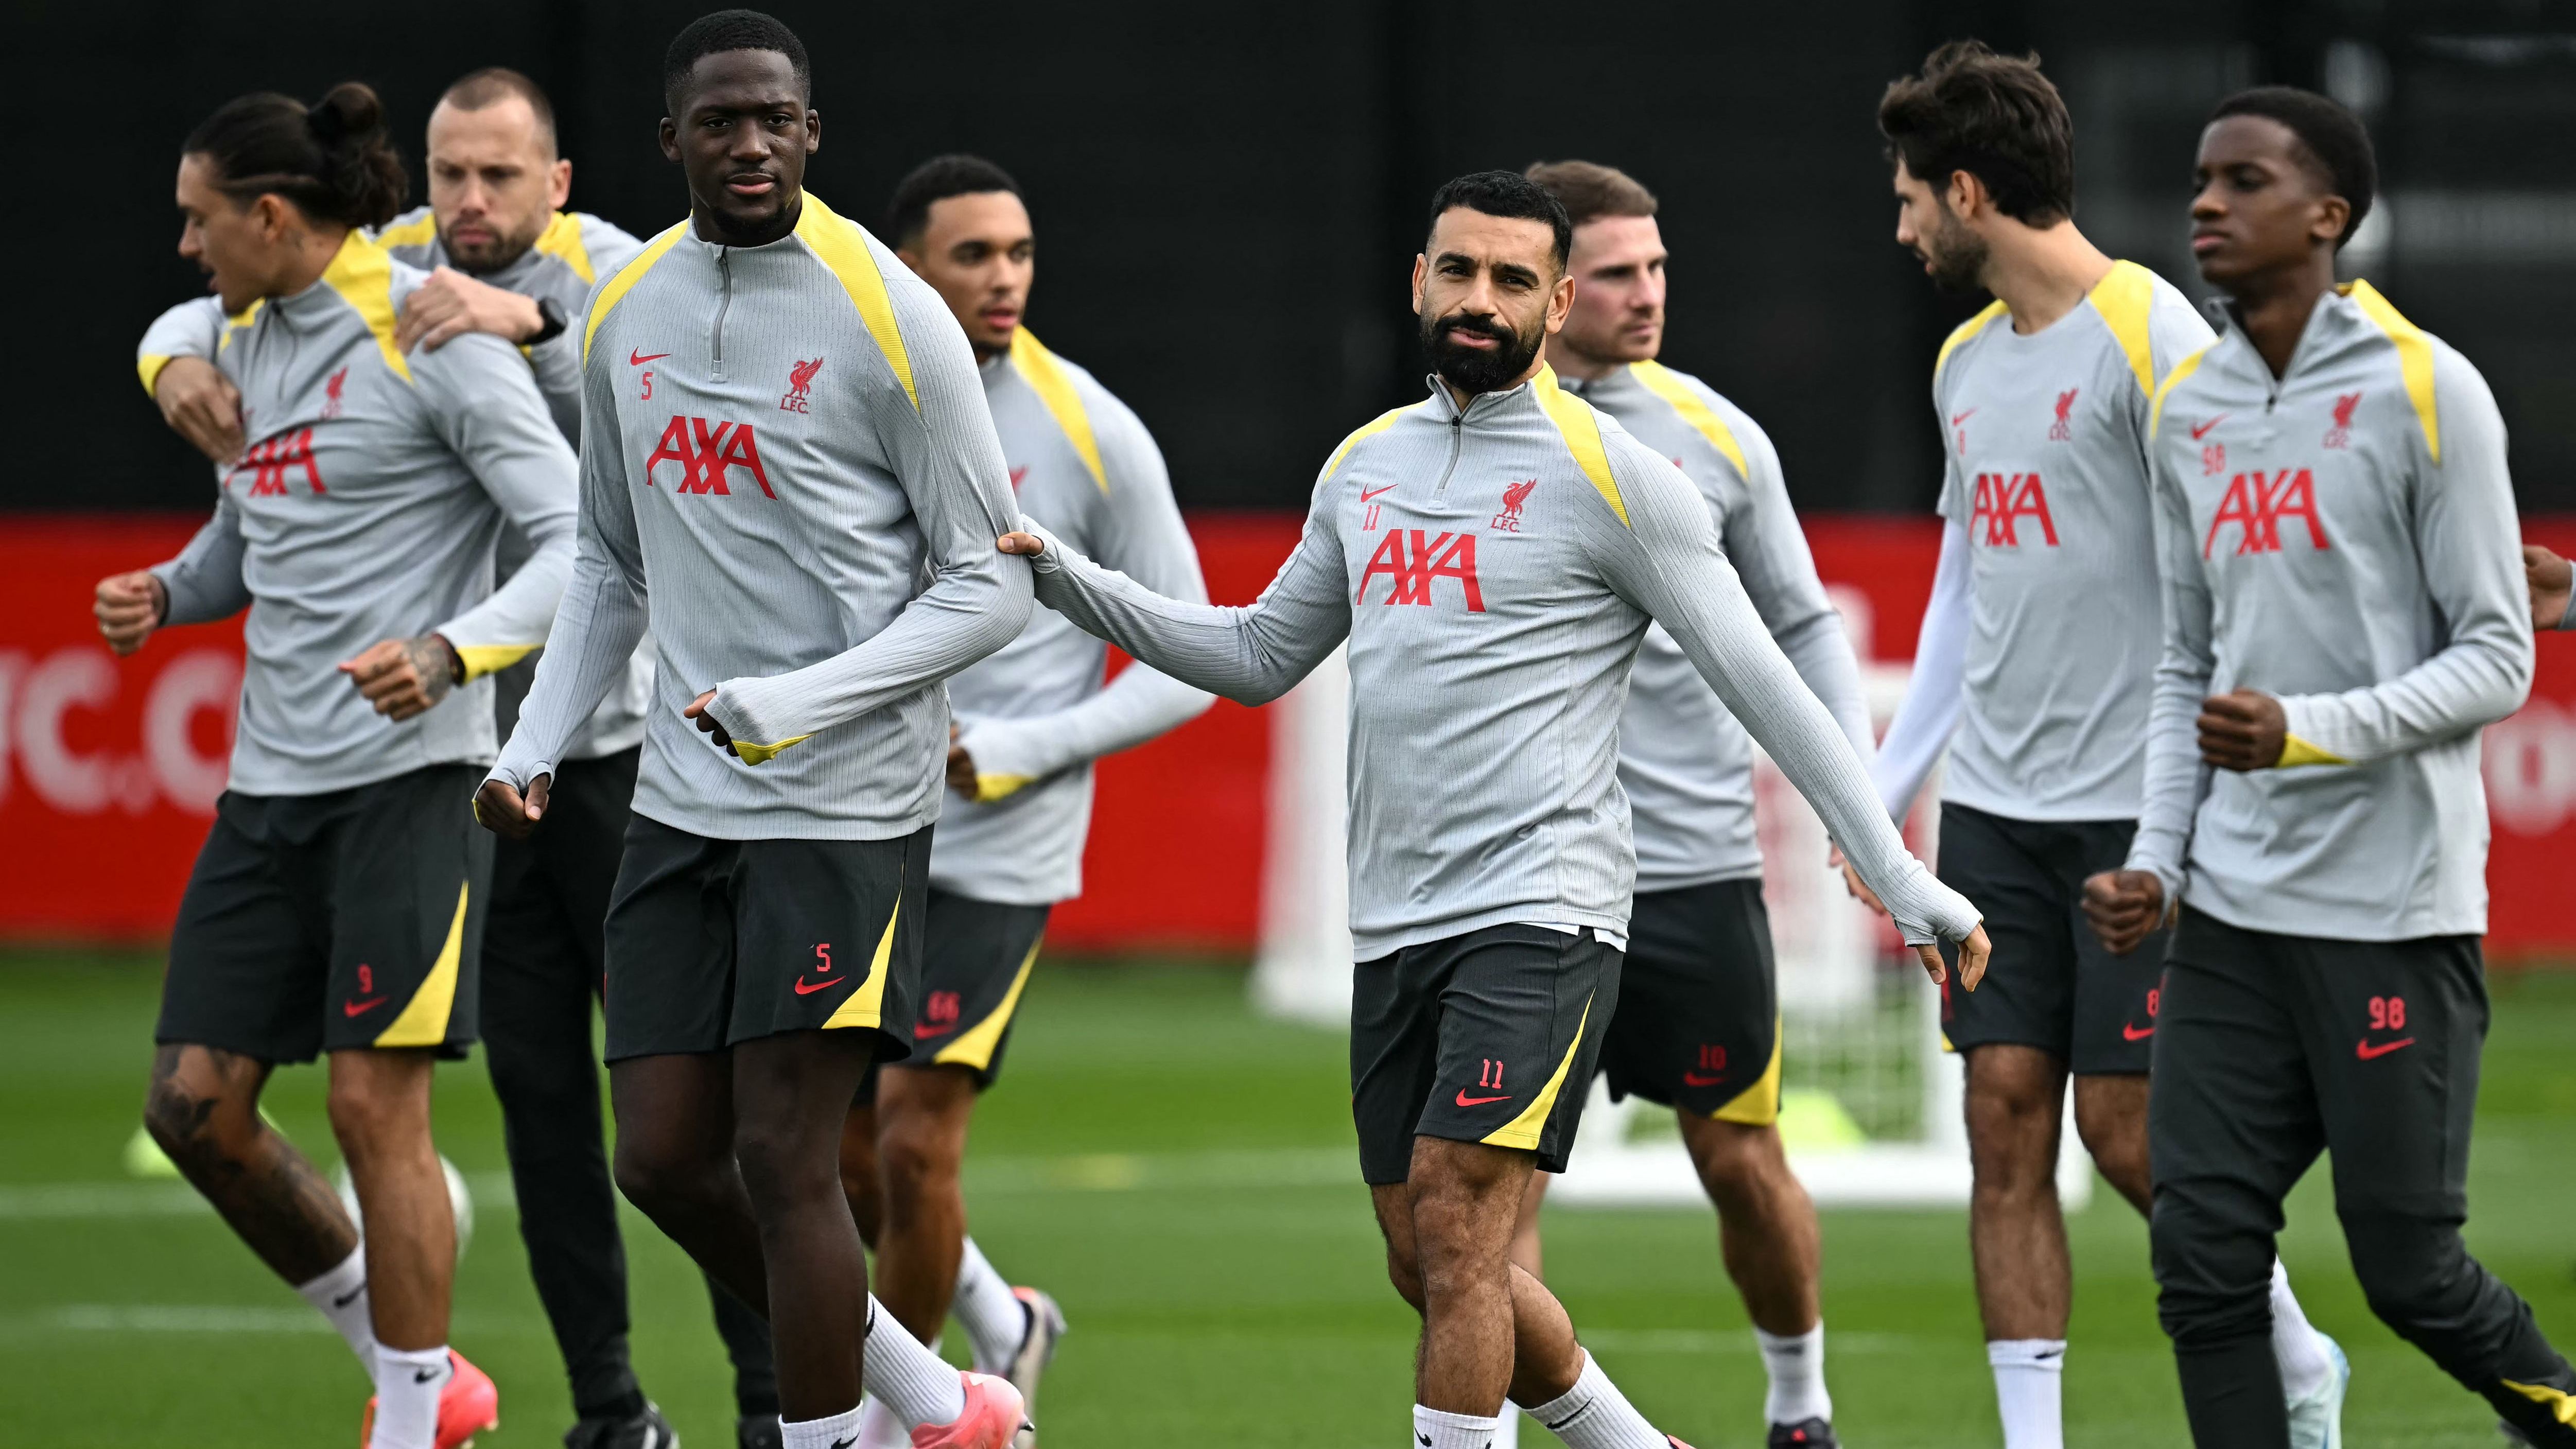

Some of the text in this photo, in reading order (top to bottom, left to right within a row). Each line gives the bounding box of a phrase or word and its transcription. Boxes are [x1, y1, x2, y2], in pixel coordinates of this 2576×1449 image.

[641, 372, 653, 400] 5
[647, 415, 777, 500] AXA
[1363, 504, 1381, 531] 11
[1969, 473, 2061, 547] AXA
[2204, 469, 2330, 560] AXA
[1356, 529, 1487, 613] AXA
[816, 944, 831, 972] 5
[358, 964, 373, 993] 9
[2147, 989, 2160, 1017] 8
[2369, 997, 2405, 1029] 98
[1699, 1043, 1727, 1070] 10
[1479, 1059, 1504, 1089] 11
